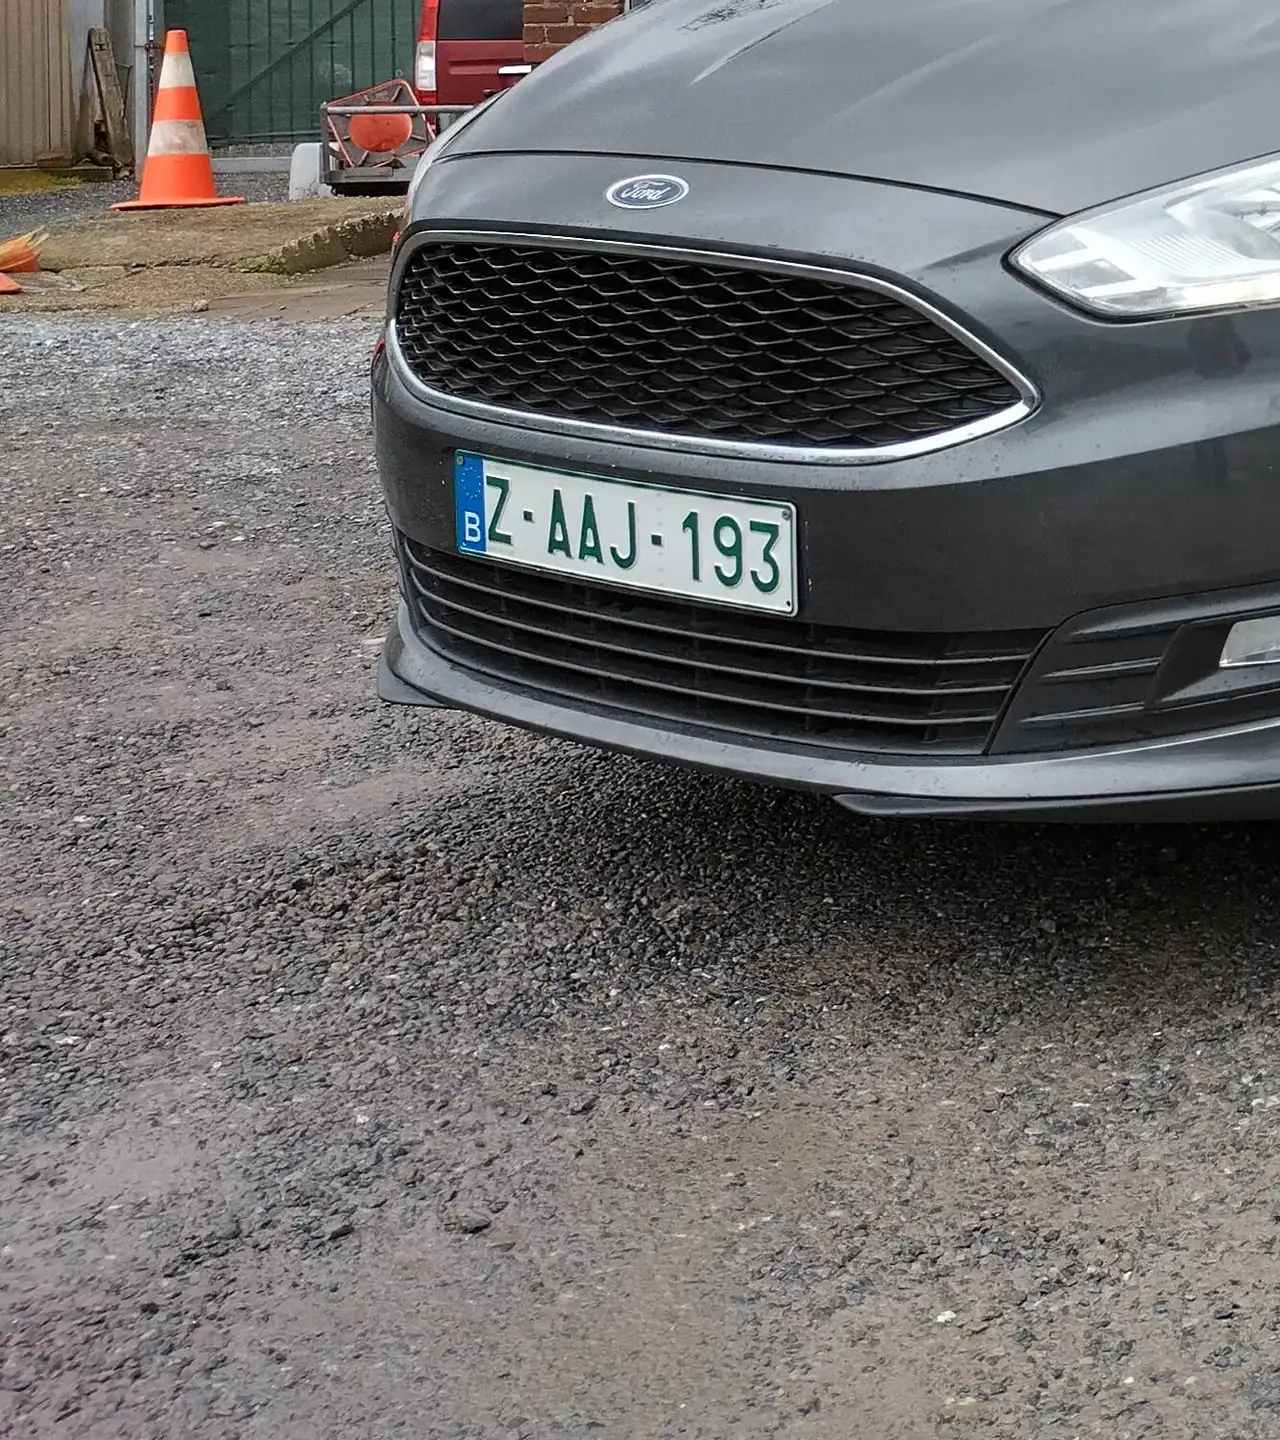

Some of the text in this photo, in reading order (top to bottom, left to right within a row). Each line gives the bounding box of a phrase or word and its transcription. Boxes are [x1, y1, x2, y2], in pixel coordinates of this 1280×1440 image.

[620, 180, 672, 201] Ford
[464, 512, 481, 543] B
[485, 475, 780, 594] Z-AAJ-193
